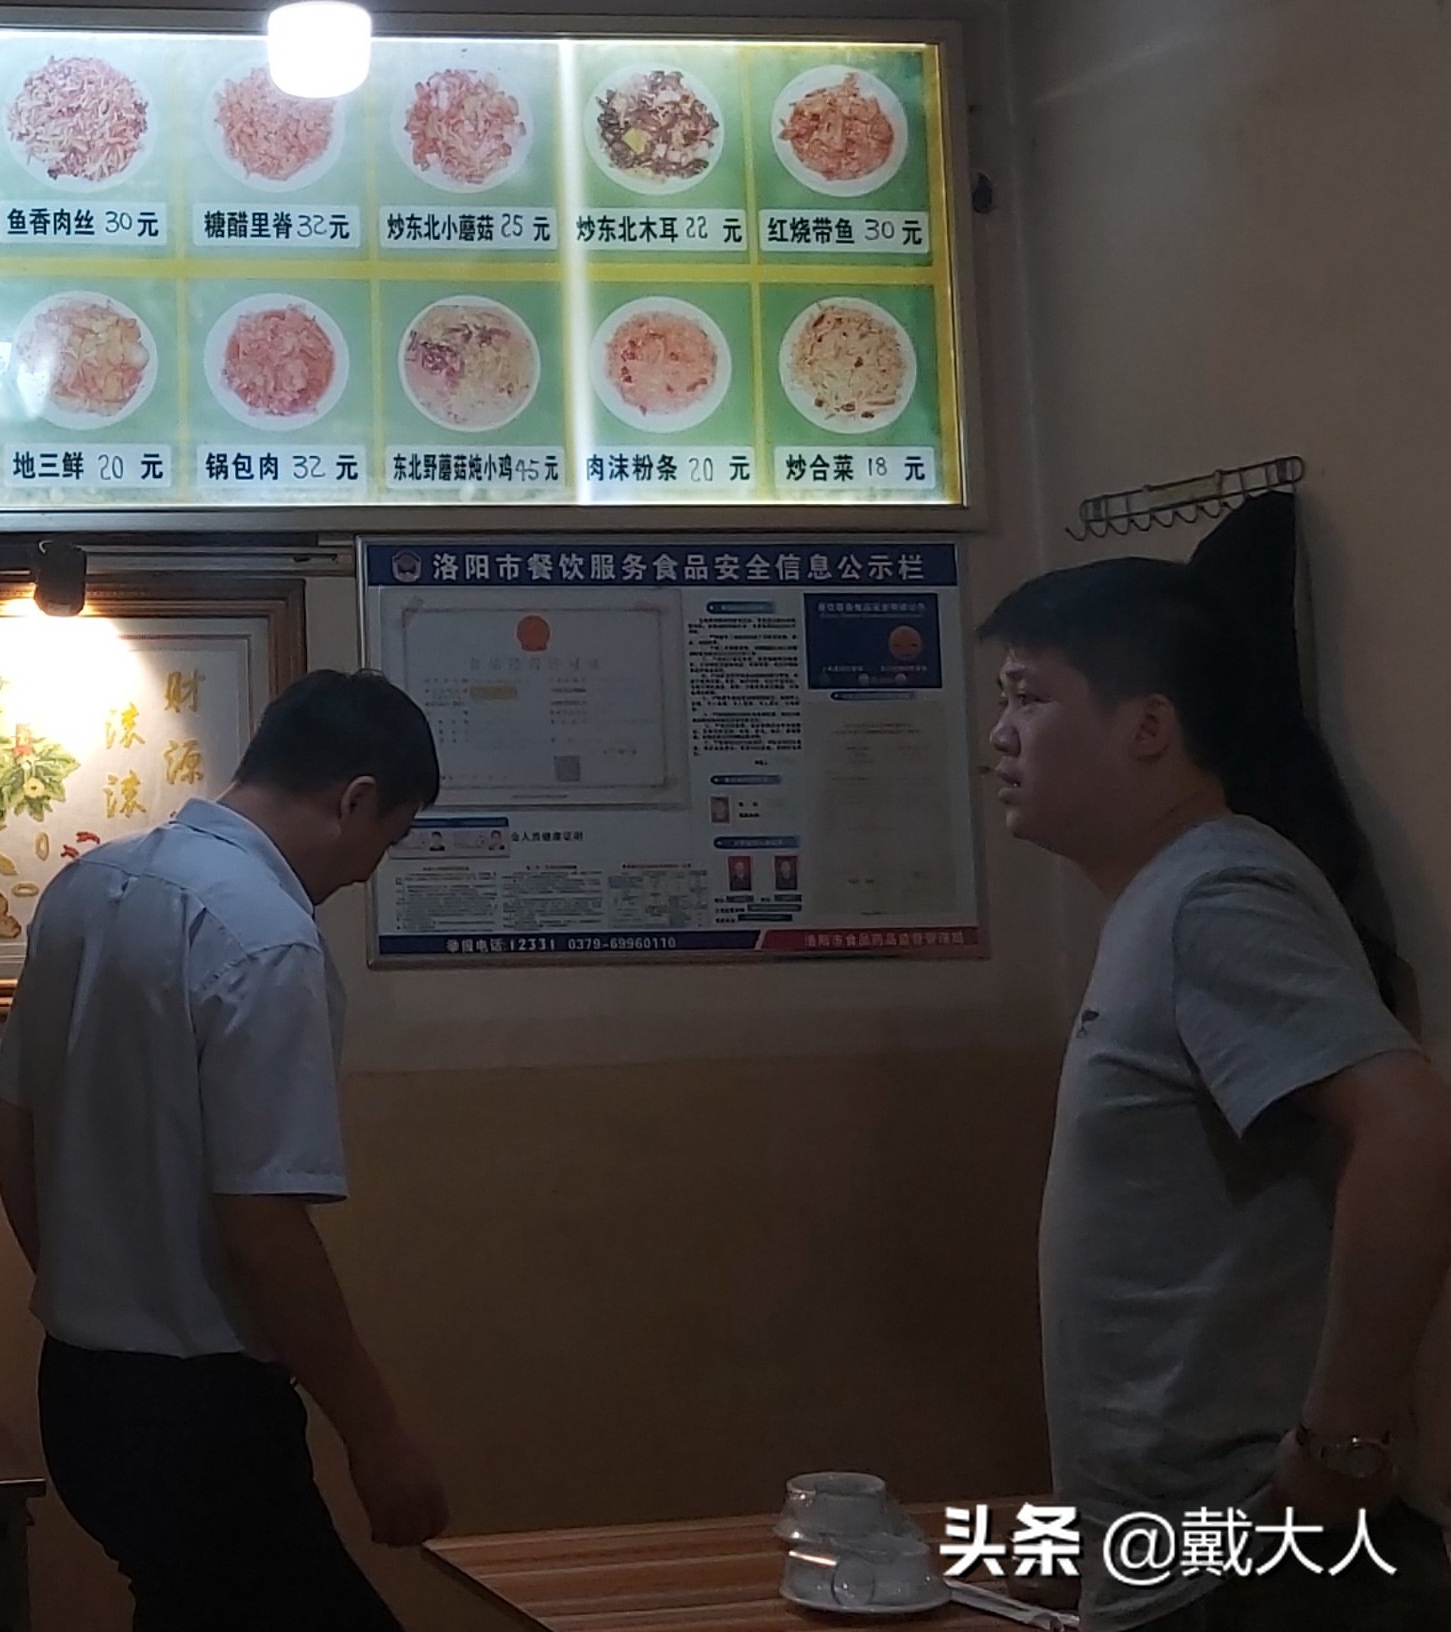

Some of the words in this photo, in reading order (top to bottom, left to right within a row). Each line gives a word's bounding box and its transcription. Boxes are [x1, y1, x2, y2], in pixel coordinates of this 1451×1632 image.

[433, 551, 925, 582] 洛阳市餐饮服务食品安全信息公示栏
